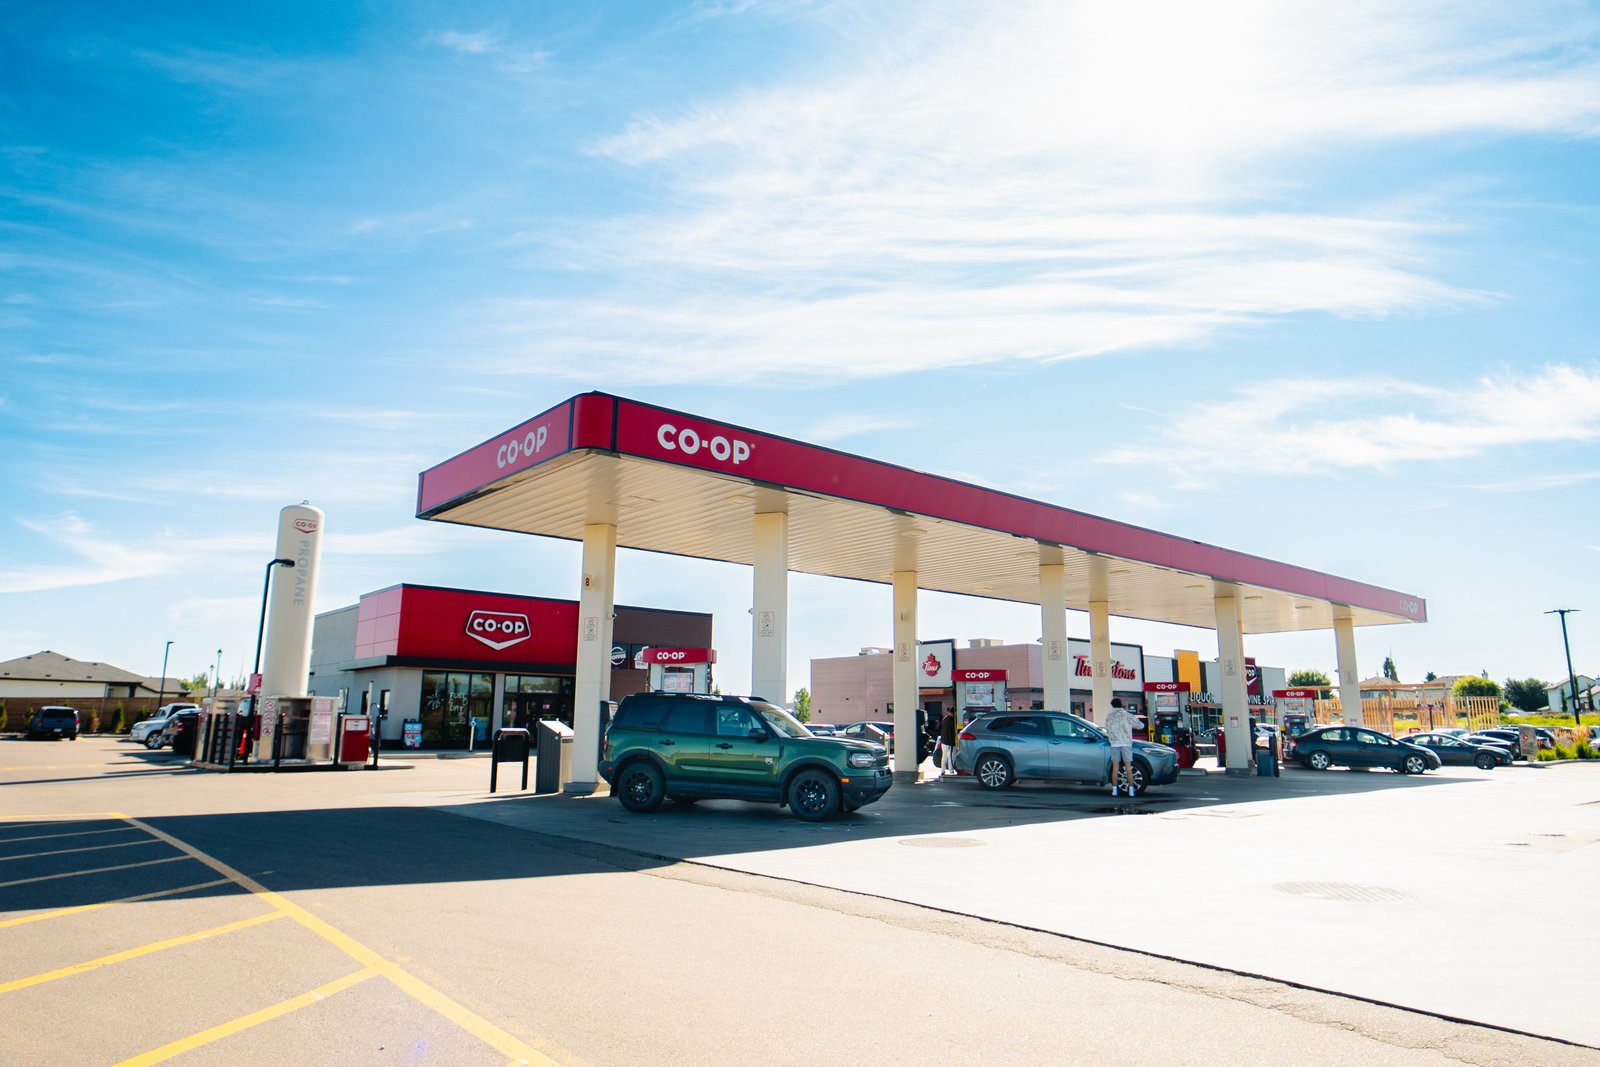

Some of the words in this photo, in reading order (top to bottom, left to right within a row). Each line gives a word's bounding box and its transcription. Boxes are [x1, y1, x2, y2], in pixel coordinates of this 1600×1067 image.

[496, 425, 548, 469] CO-OP
[657, 423, 750, 465] CO-OP
[293, 540, 311, 606] PROPANE
[585, 577, 590, 587] 8
[473, 618, 525, 634] CO-OP
[656, 651, 686, 660] CO-OP
[1111, 660, 1136, 680] tons
